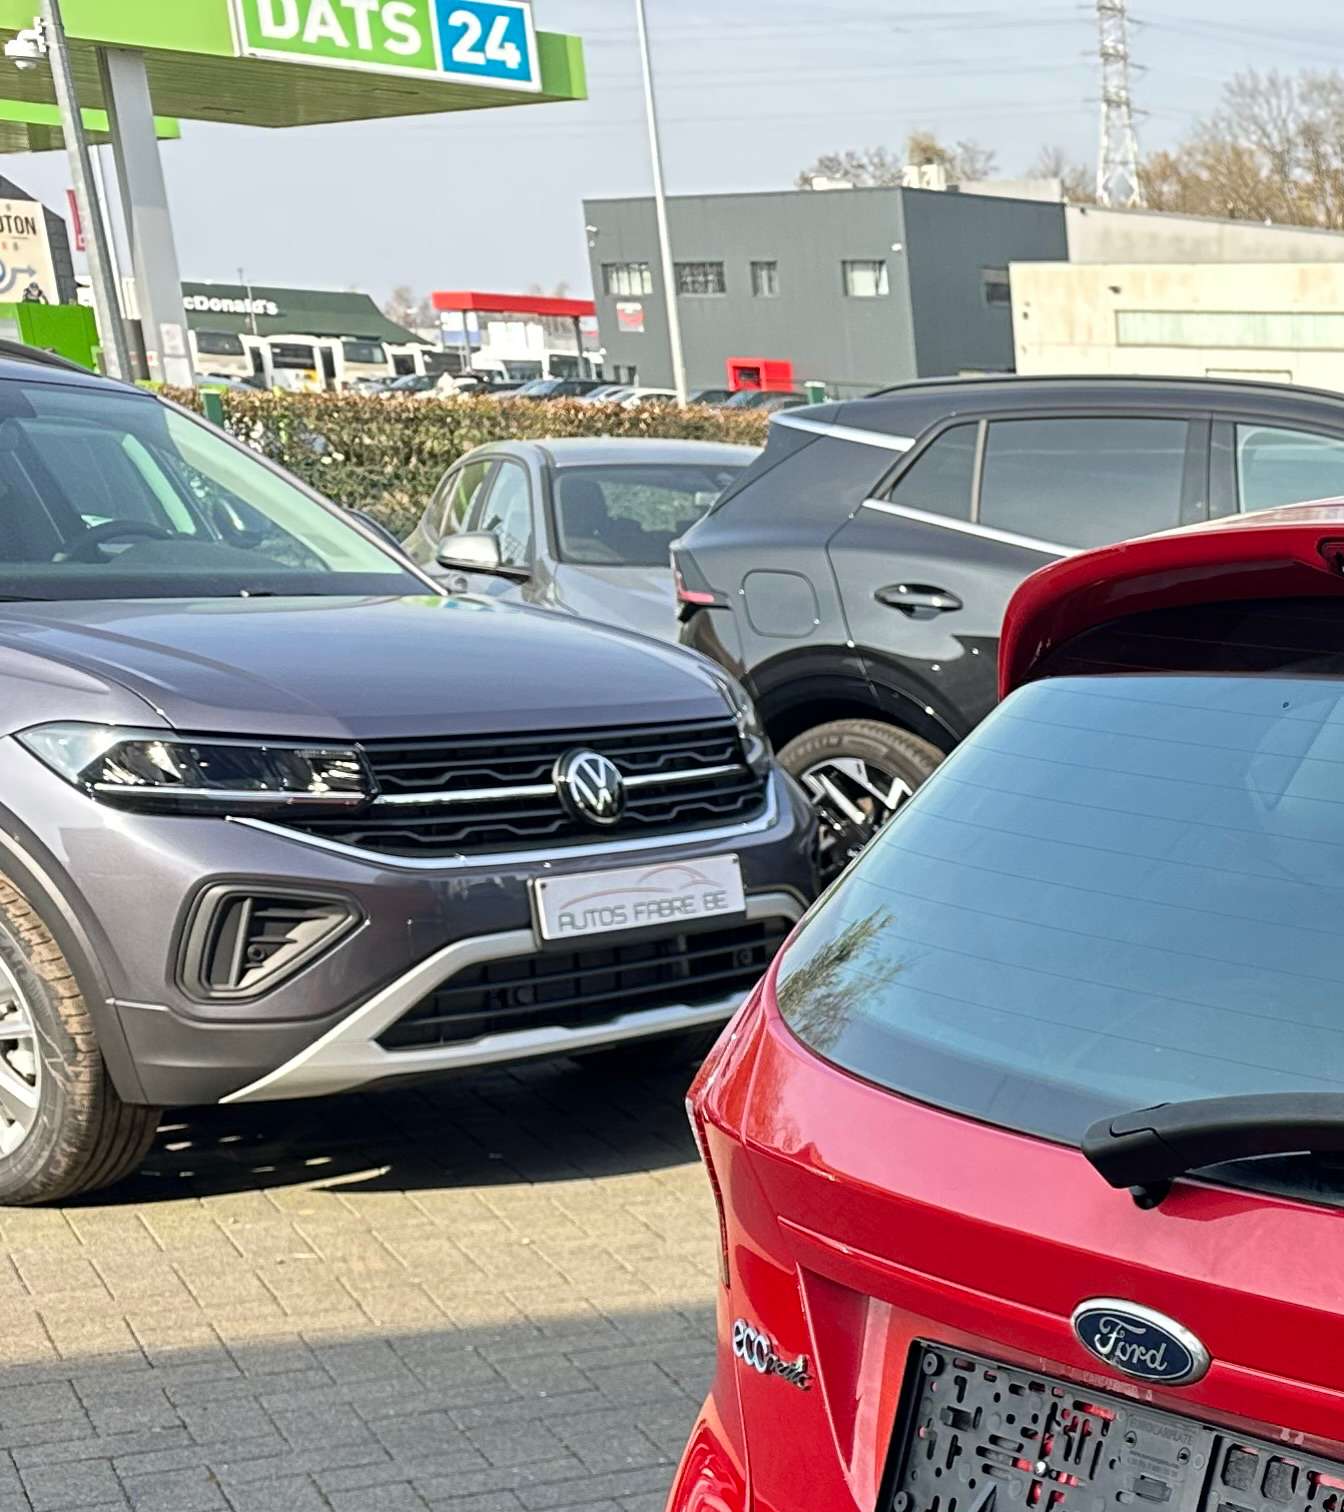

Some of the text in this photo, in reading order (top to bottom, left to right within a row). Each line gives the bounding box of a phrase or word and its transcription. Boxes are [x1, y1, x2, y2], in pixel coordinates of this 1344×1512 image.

[256, 0, 522, 69] DATS 24
[184, 294, 279, 316] cDonald's
[558, 889, 729, 931] AUTOS FABRE BE
[1093, 1316, 1168, 1371] Ford
